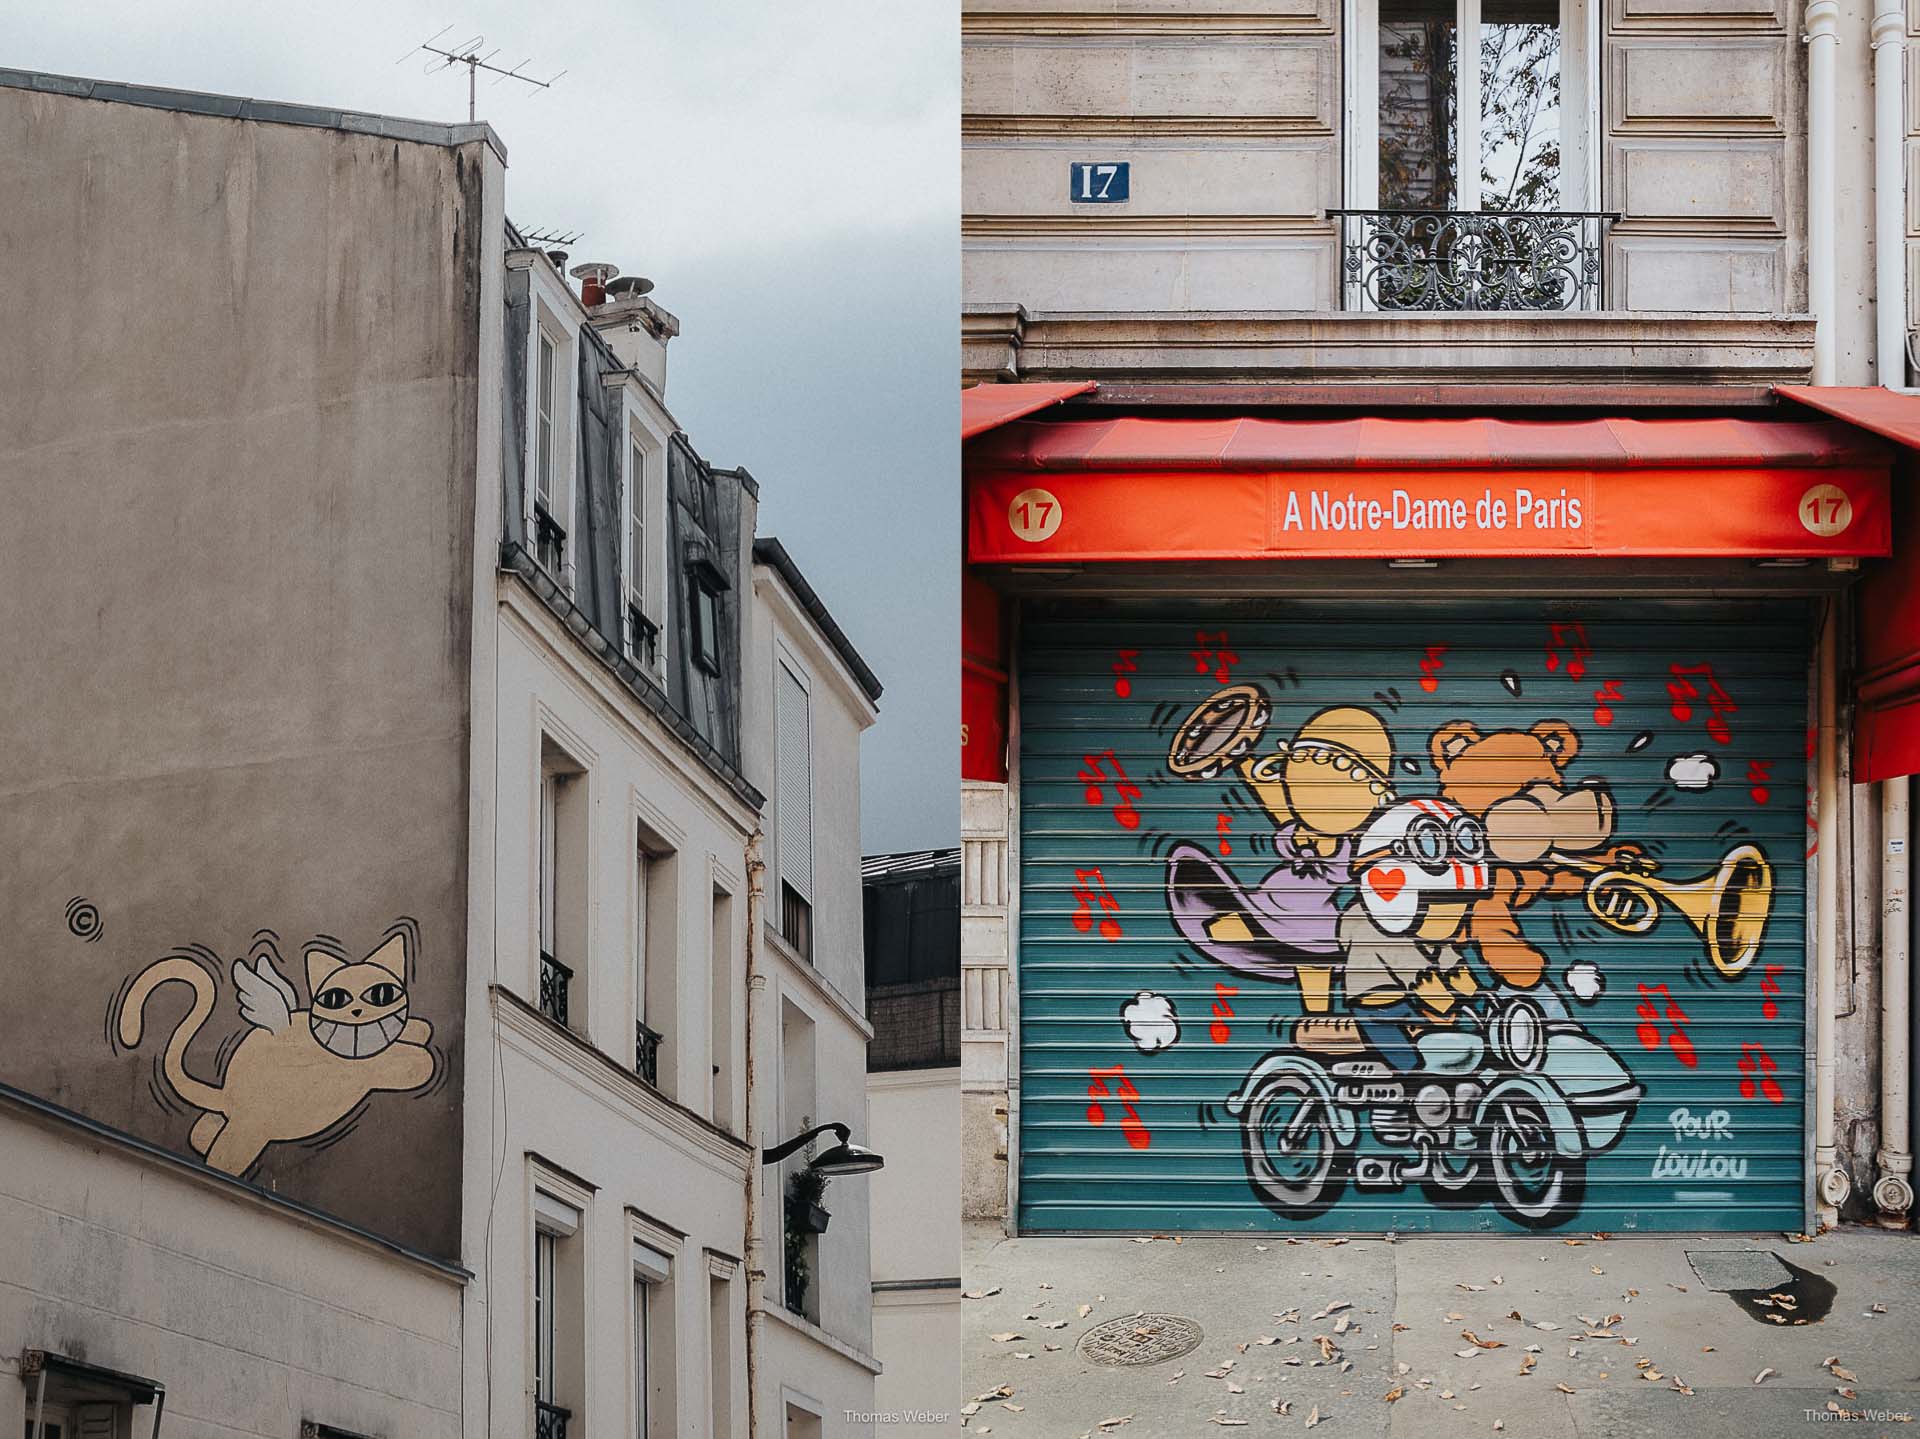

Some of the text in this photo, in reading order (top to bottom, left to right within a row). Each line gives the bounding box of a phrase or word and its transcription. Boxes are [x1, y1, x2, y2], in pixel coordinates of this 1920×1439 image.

[1081, 165, 1118, 198] 17
[1016, 502, 1054, 530] 17
[1282, 488, 1583, 531] A Notre-Dame de Paris
[1806, 497, 1845, 525] 17
